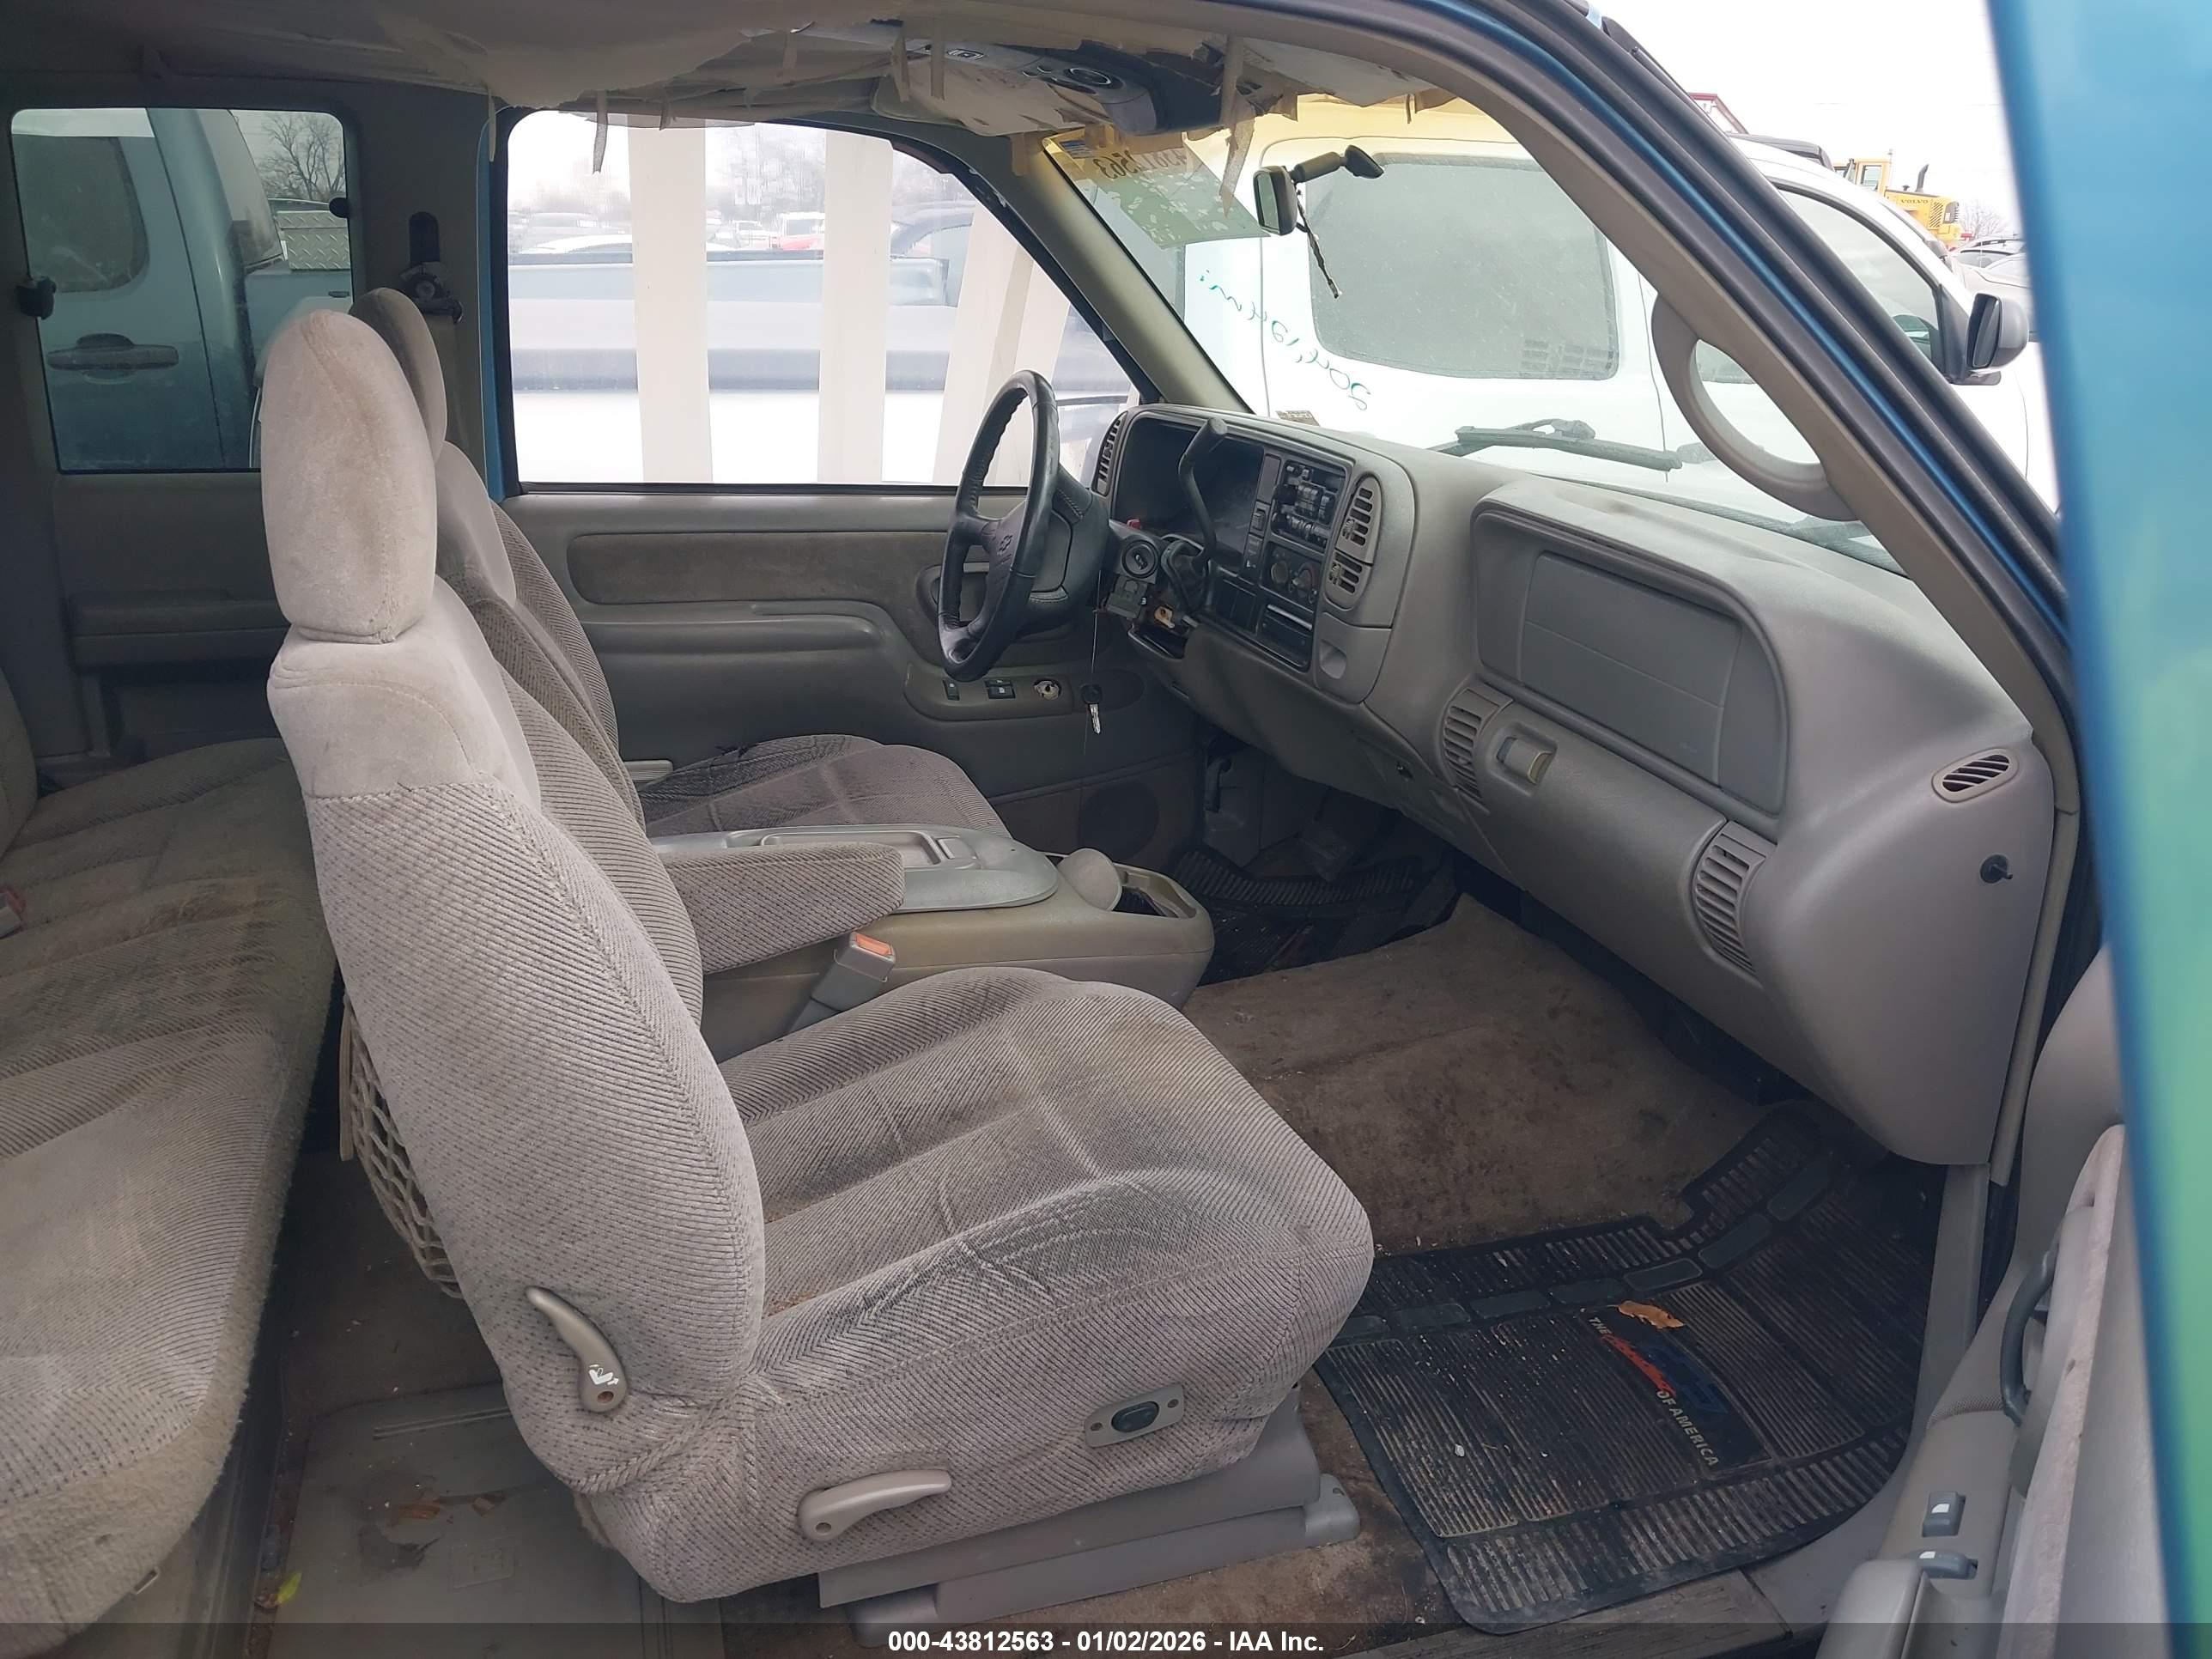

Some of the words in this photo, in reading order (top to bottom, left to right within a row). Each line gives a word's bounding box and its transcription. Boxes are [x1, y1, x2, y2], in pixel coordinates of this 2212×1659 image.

[1589, 1316, 1613, 1334] THE
[1656, 1389, 1677, 1406] OF
[1668, 1407, 1719, 1467] AMERICA
